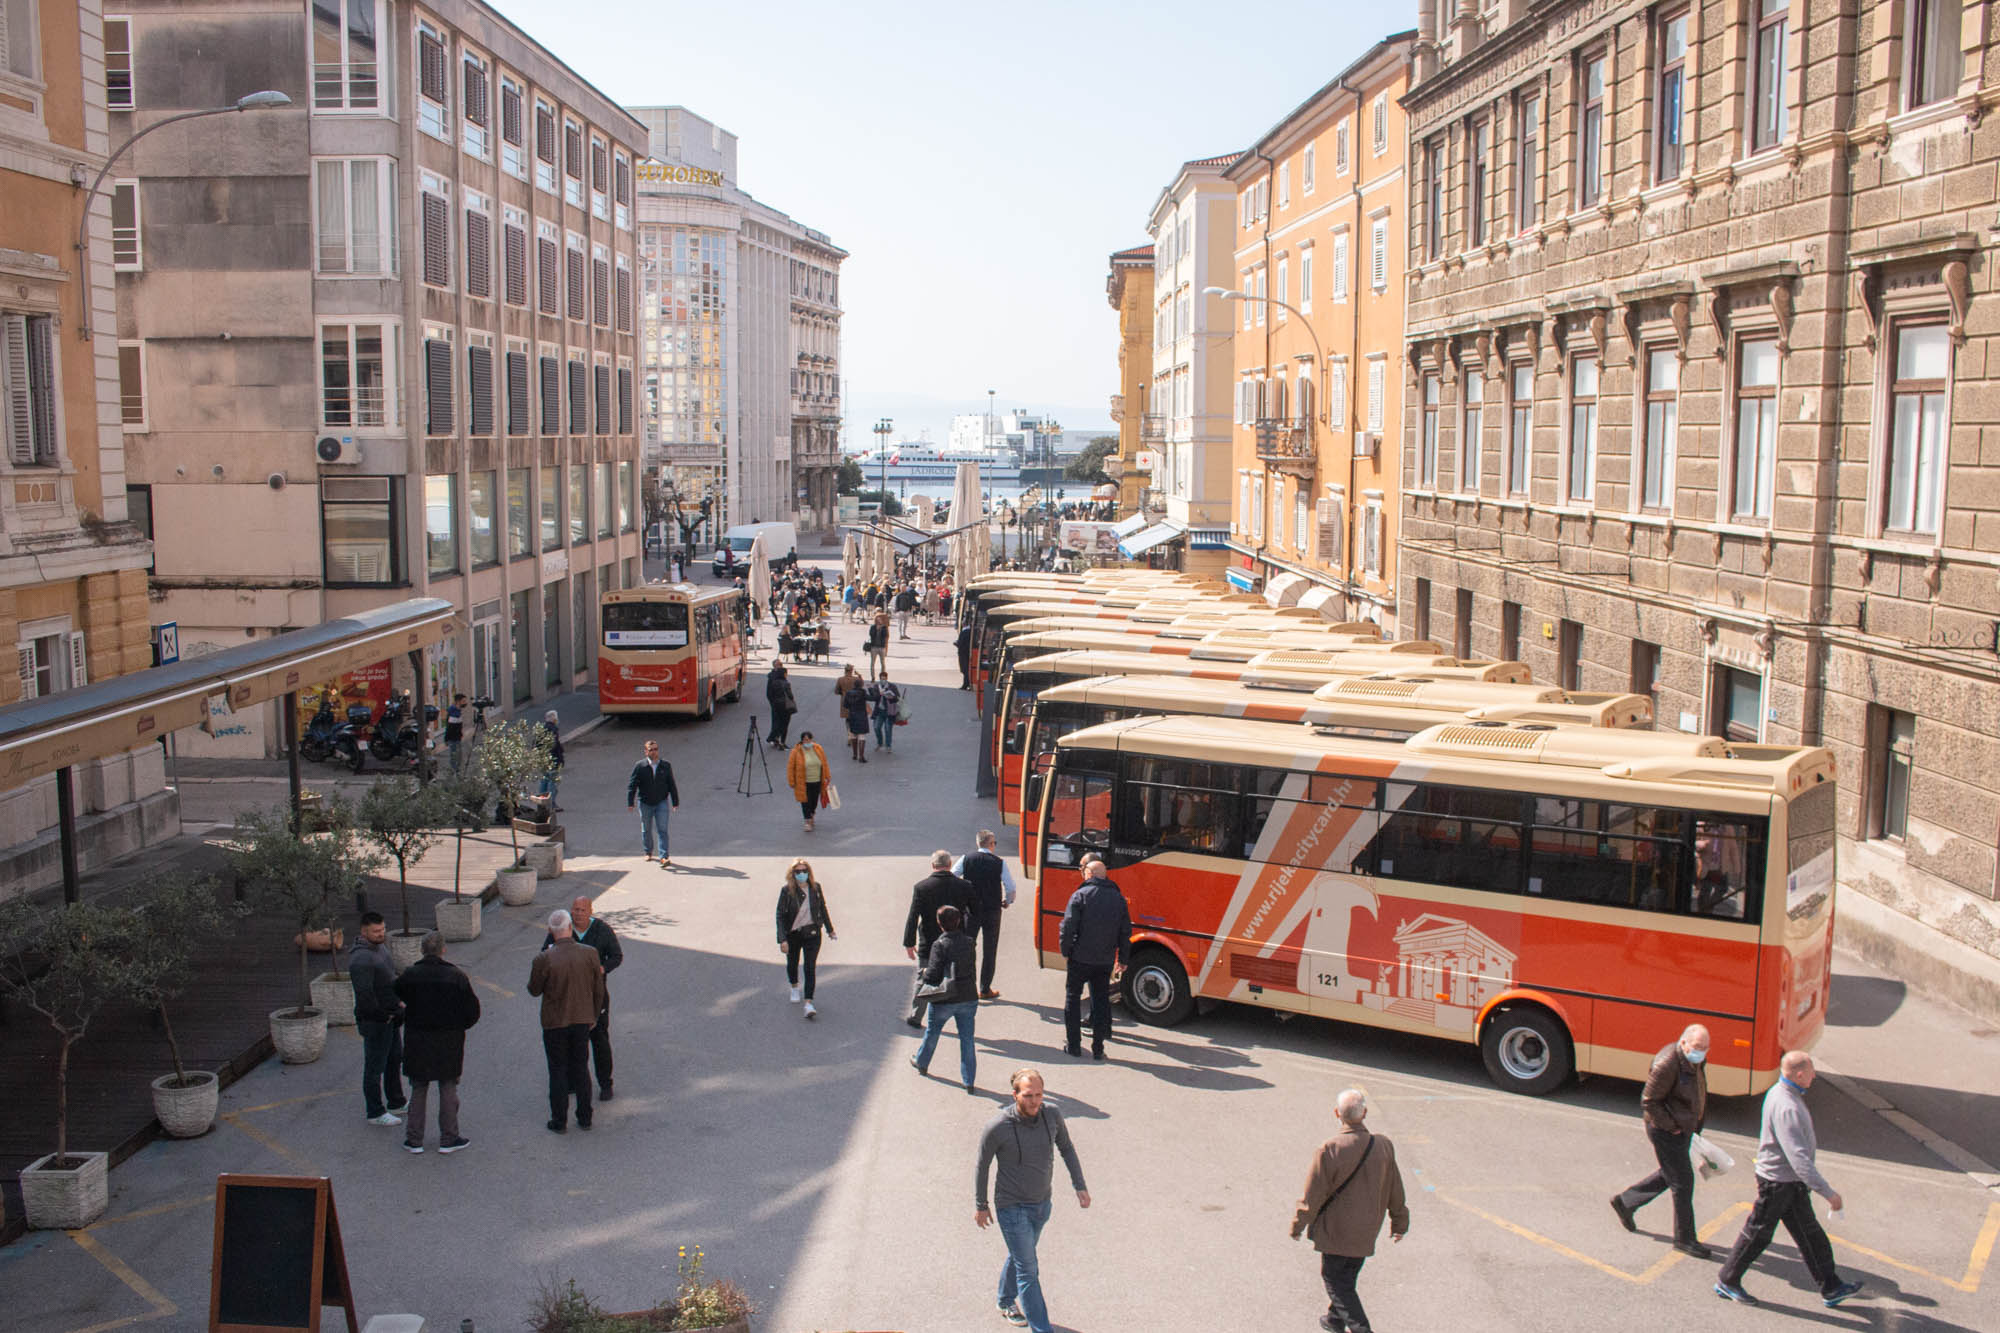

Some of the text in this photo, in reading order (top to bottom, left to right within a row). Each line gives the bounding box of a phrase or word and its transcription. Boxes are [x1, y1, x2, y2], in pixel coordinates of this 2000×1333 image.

[911, 467, 956, 475] JADROLIN
[1242, 779, 1353, 940] www.rijekacitycard.hr
[1317, 973, 1338, 987] 121
